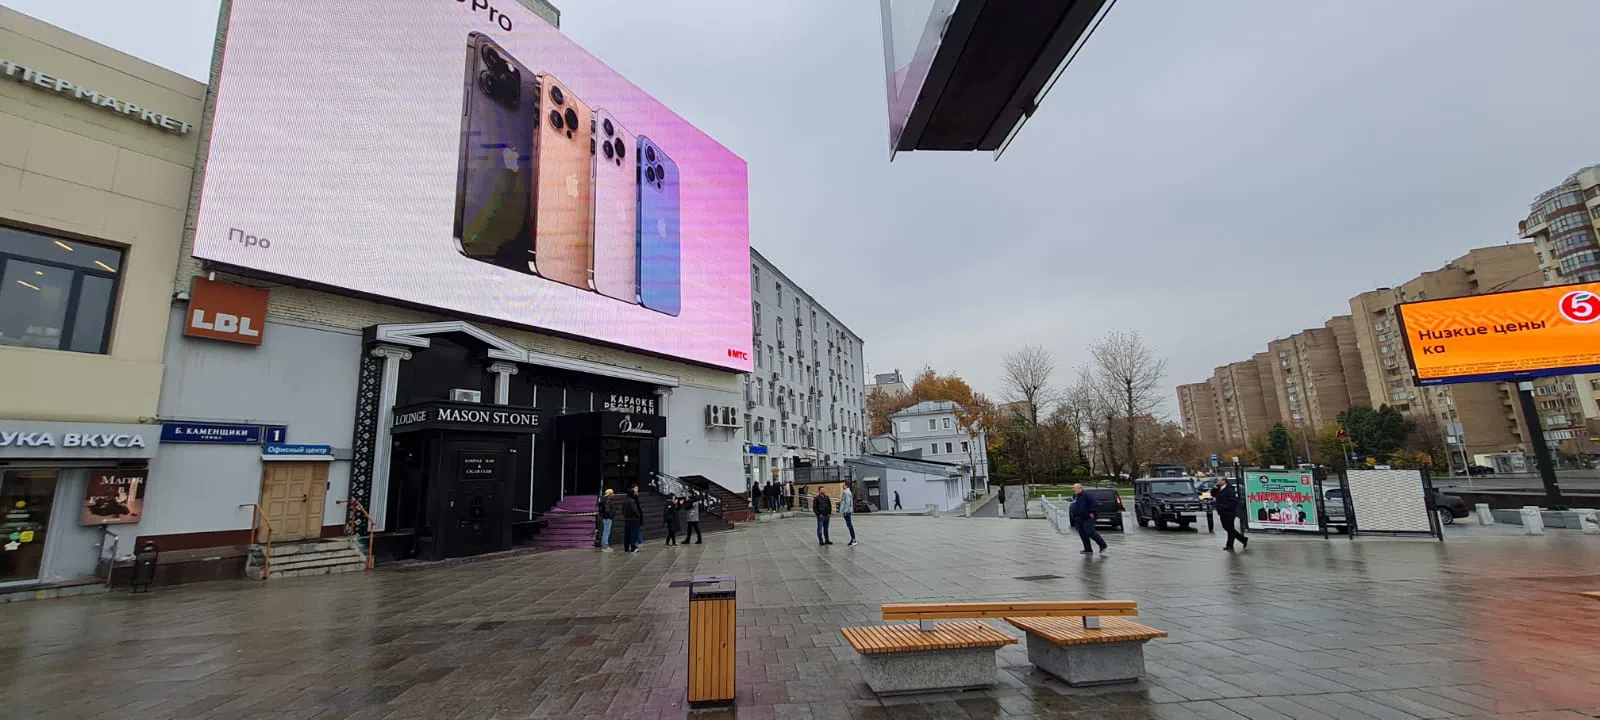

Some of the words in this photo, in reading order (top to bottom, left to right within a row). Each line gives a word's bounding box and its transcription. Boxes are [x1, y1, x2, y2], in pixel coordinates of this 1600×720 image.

[229, 228, 270, 248] Про
[191, 309, 259, 336] LBL
[1419, 326, 1488, 341] Низкие
[1494, 320, 1546, 335] цены
[1423, 345, 1446, 355] ка
[610, 394, 655, 408] КАРАОКЕ
[395, 411, 427, 426] LOUNGE
[438, 408, 490, 422] MASON
[493, 412, 539, 426] ST.ONE
[187, 428, 248, 436] КАМЕНЩИКИ
[273, 430, 280, 441] 1
[63, 433, 145, 448] ВКУСА
